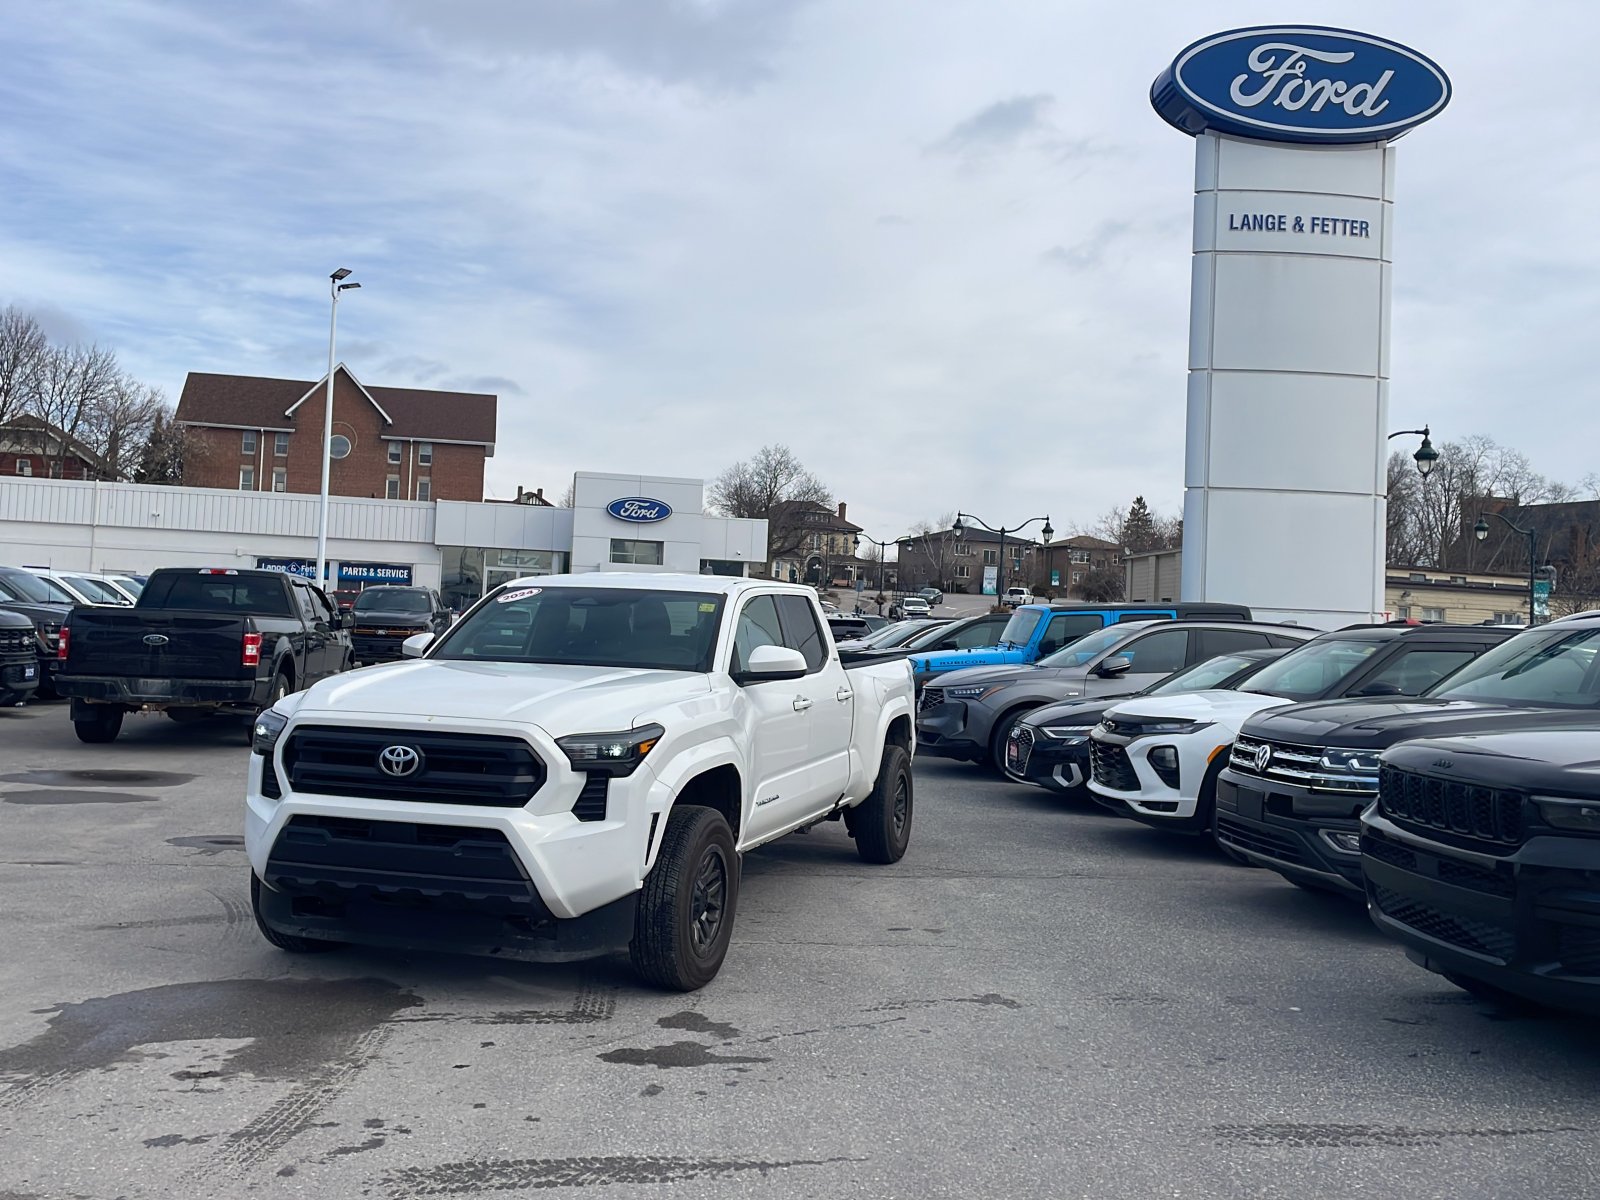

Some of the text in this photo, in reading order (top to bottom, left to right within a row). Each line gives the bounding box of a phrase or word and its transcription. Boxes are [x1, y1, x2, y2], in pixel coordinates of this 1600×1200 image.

[1230, 42, 1395, 117] Ford
[1229, 213, 1370, 238] LANGE & FETTER
[620, 500, 660, 518] Ford
[342, 566, 409, 579] PARTS & SERVICE
[503, 590, 534, 601] 2024
